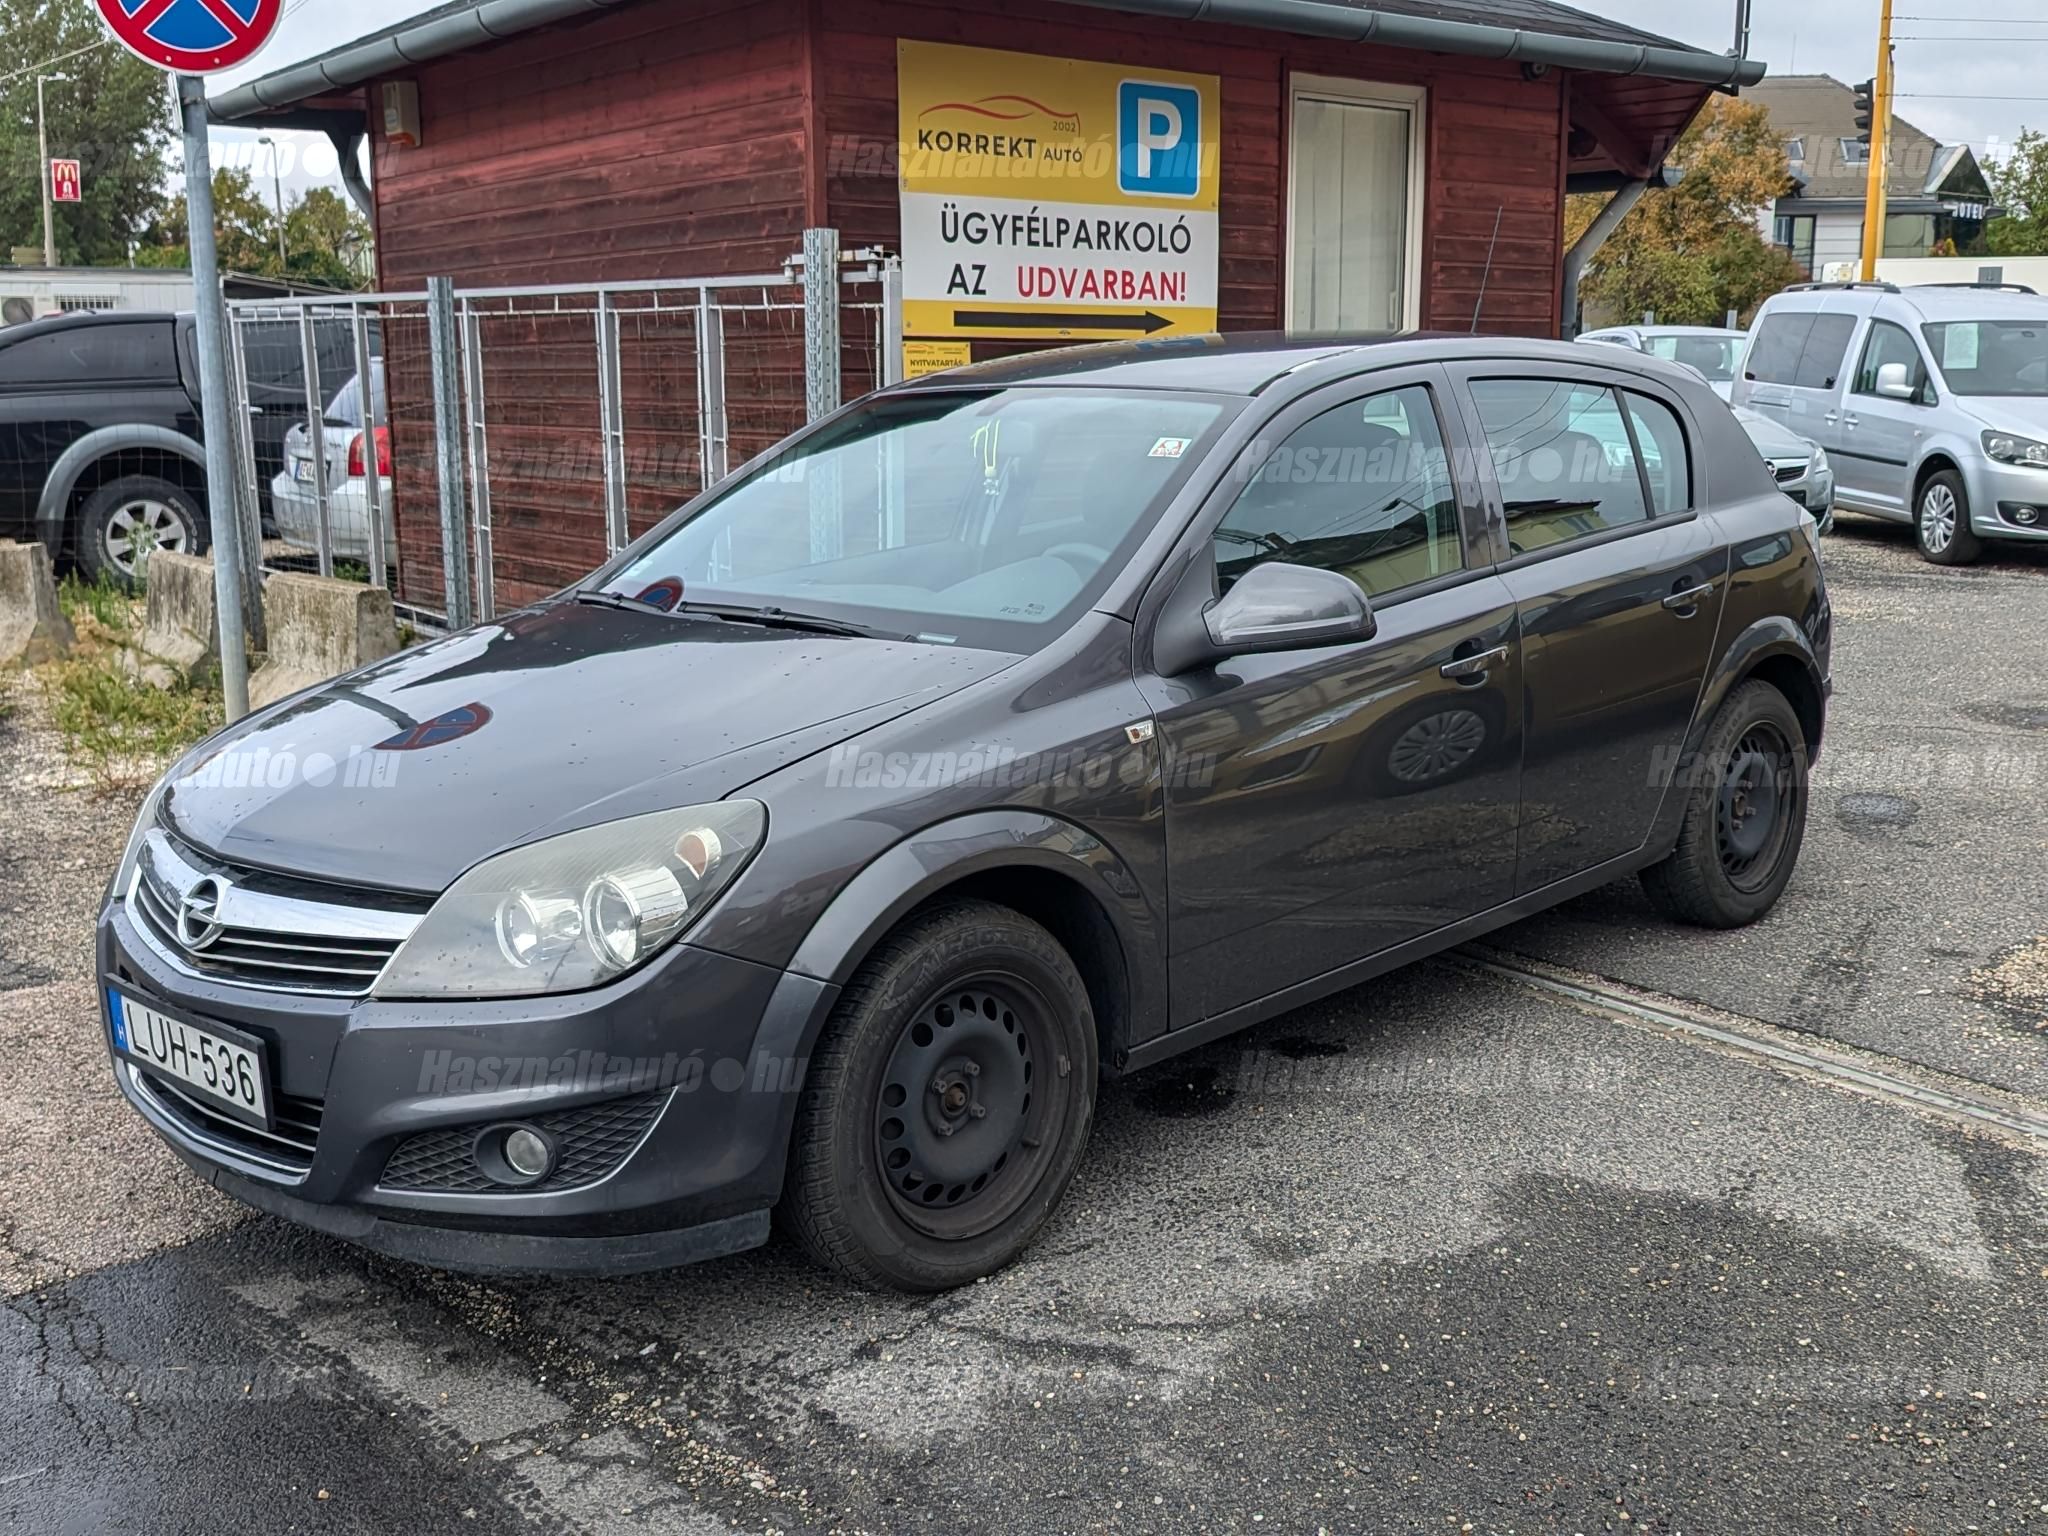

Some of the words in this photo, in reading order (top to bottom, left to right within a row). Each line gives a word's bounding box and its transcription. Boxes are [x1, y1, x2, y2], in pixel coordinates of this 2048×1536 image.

[918, 128, 1037, 160] KORREKT
[1043, 147, 1083, 163] AUTÓ
[1052, 120, 1076, 133] 2002
[1137, 97, 1183, 179] P
[940, 202, 1192, 255] ÜGYFÉLPARKOLÓ
[946, 263, 987, 296] AZ
[1017, 265, 1187, 302] UDVARBAN!
[118, 1024, 125, 1041] H
[126, 1003, 256, 1106] LUH-536
